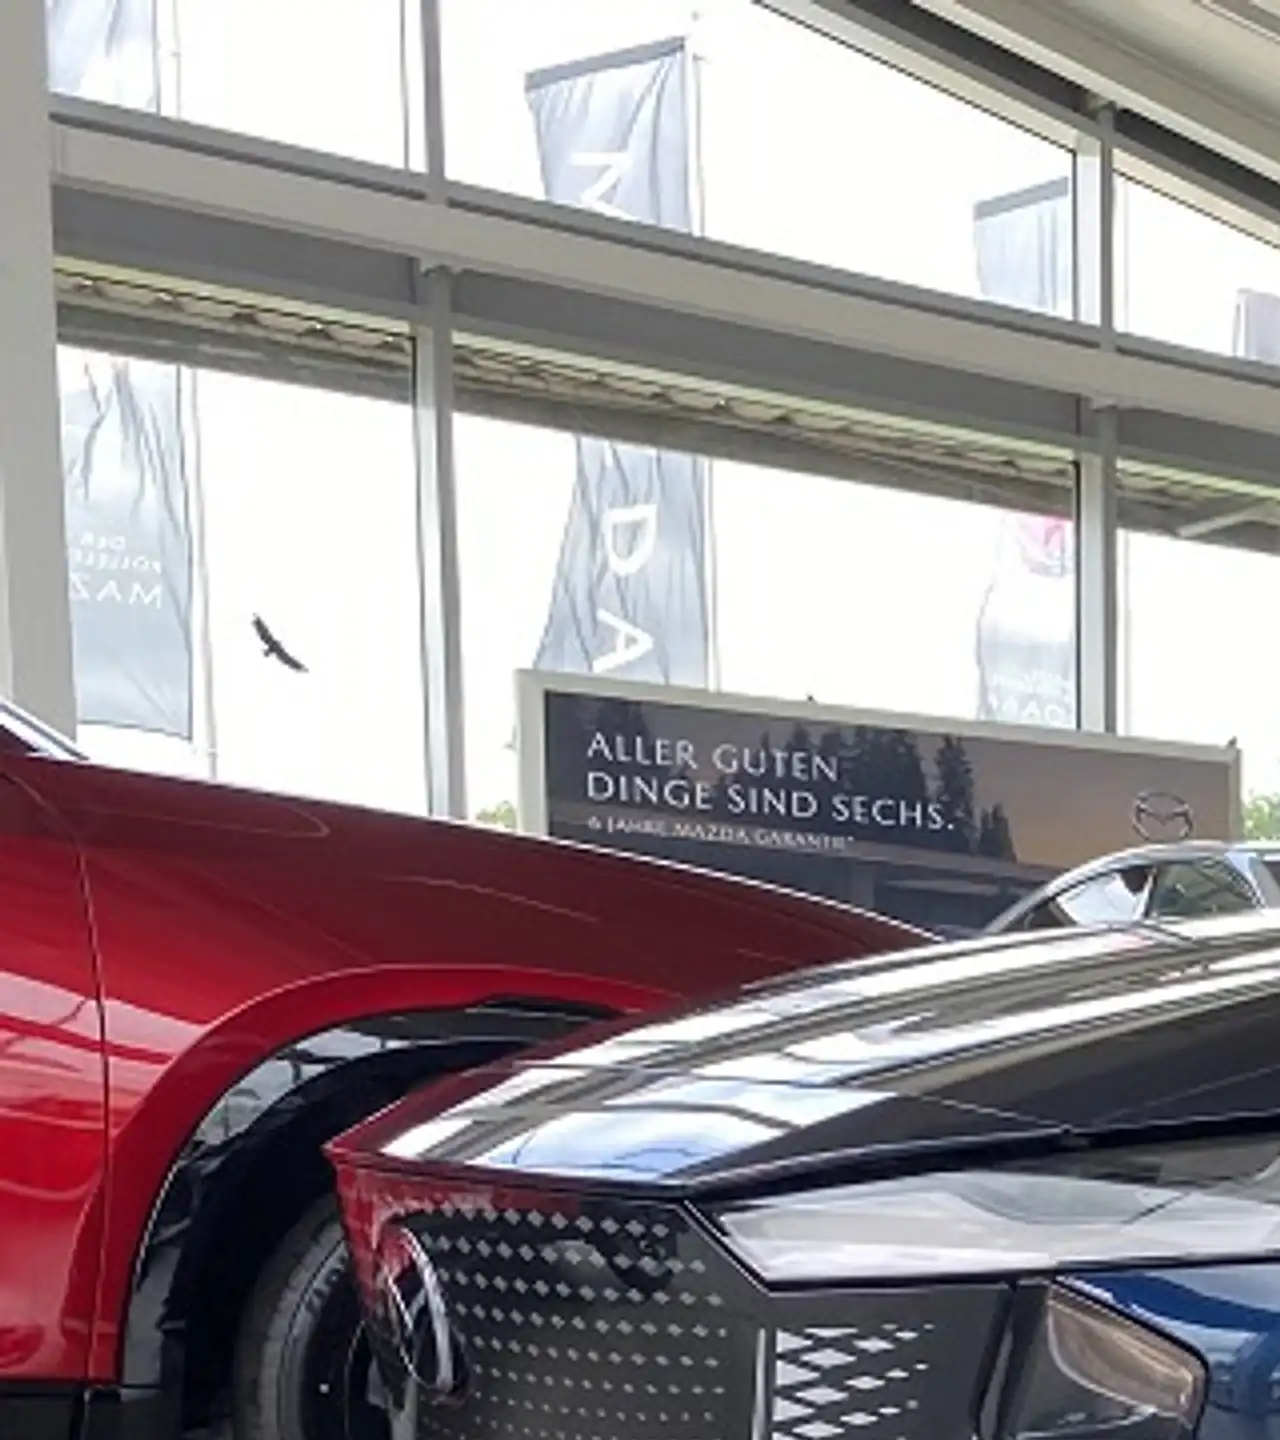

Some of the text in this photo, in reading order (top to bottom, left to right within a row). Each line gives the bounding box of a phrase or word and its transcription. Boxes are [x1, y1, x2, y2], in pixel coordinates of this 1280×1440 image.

[587, 731, 839, 782] ALLER GUTEN
[587, 771, 955, 831] DINGE SIND SECHS.
